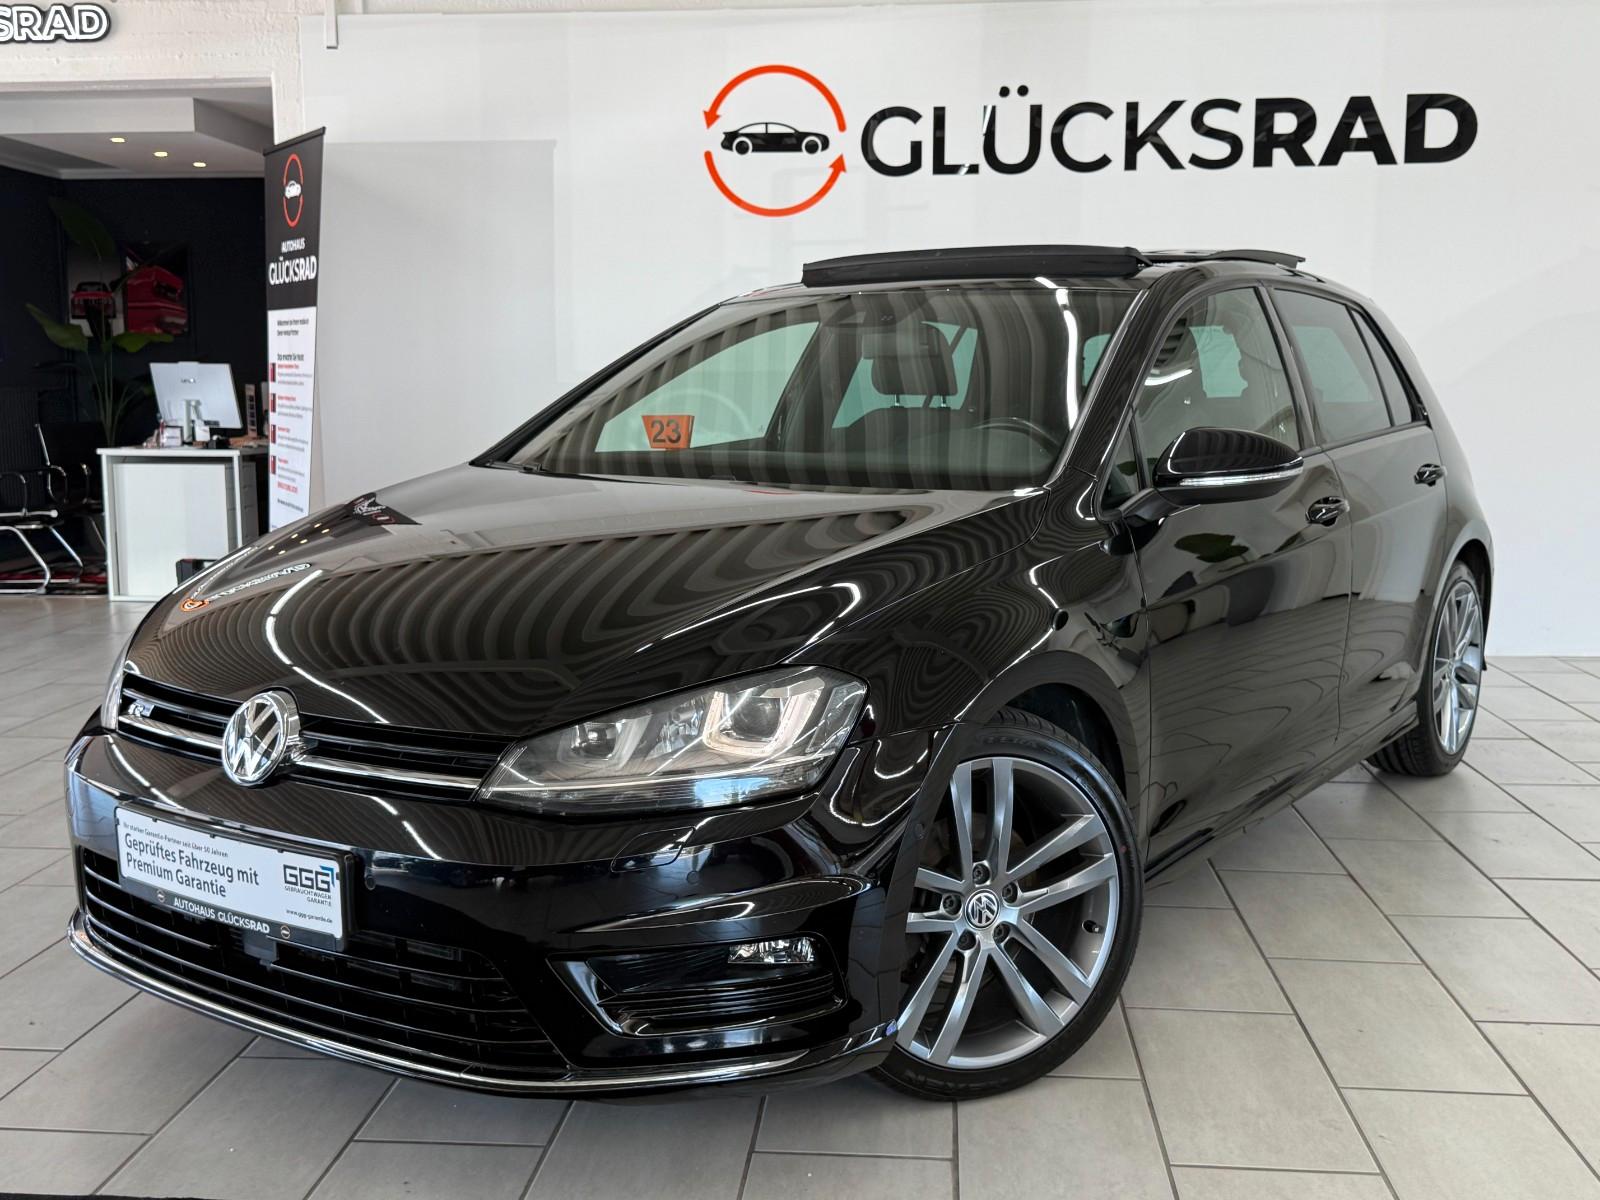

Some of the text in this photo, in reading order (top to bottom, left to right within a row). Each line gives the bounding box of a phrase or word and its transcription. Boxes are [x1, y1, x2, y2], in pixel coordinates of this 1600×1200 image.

[860, 84, 1479, 177] GLÜCKSRAD
[281, 237, 305, 253] AUTOHAUS
[268, 255, 317, 286] GLÜCKSRAD
[651, 419, 682, 444] 23
[124, 833, 259, 887] Geprüftes Fahrzeug mit
[211, 847, 229, 858] Jahren
[126, 852, 227, 898] Premium Garantie
[283, 864, 331, 893] GGG
[284, 885, 332, 900] GEBRAUCHTWAGEN
[306, 896, 332, 907] GARANTIE
[173, 897, 270, 933] AUTOHAUS GLÜCKSRAD
